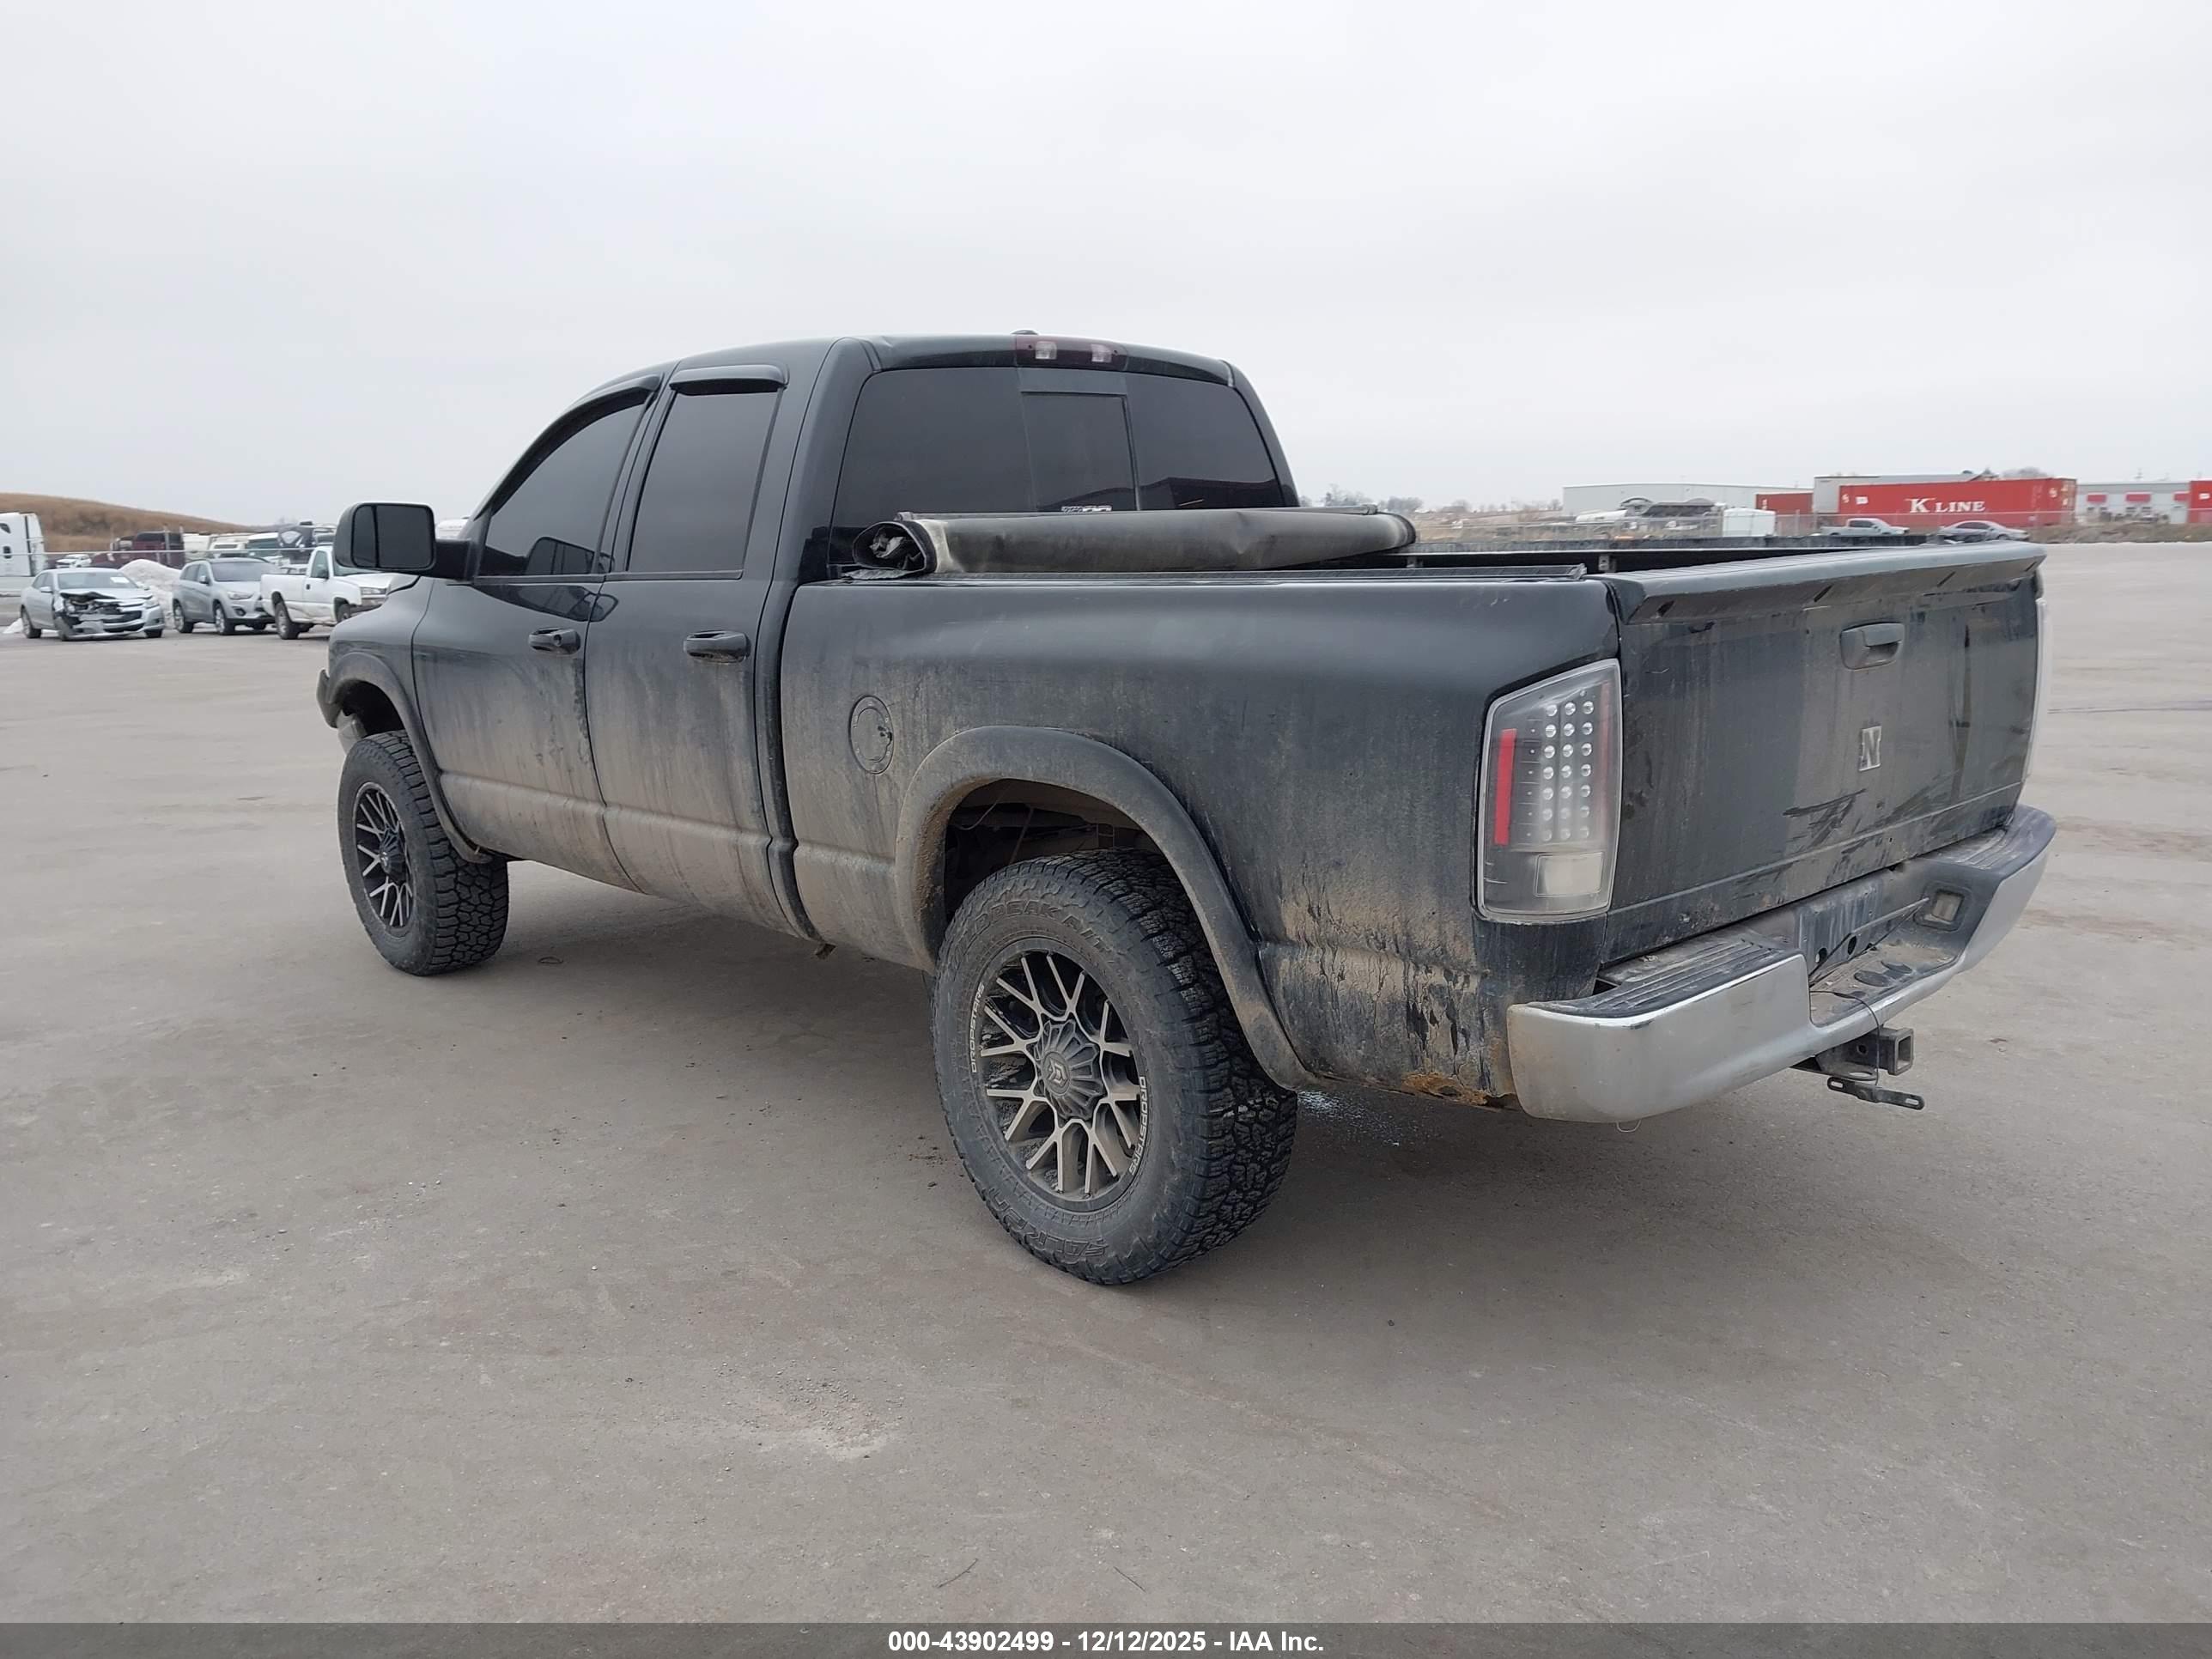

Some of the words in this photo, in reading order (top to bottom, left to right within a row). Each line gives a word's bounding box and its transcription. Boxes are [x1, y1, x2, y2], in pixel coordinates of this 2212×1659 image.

[1907, 497, 1936, 514] K
[1936, 501, 1986, 513] LINE
[1858, 726, 1882, 772] N
[969, 981, 985, 1073] DROPSTARS
[1128, 1076, 1149, 1176] DROPSTARS
